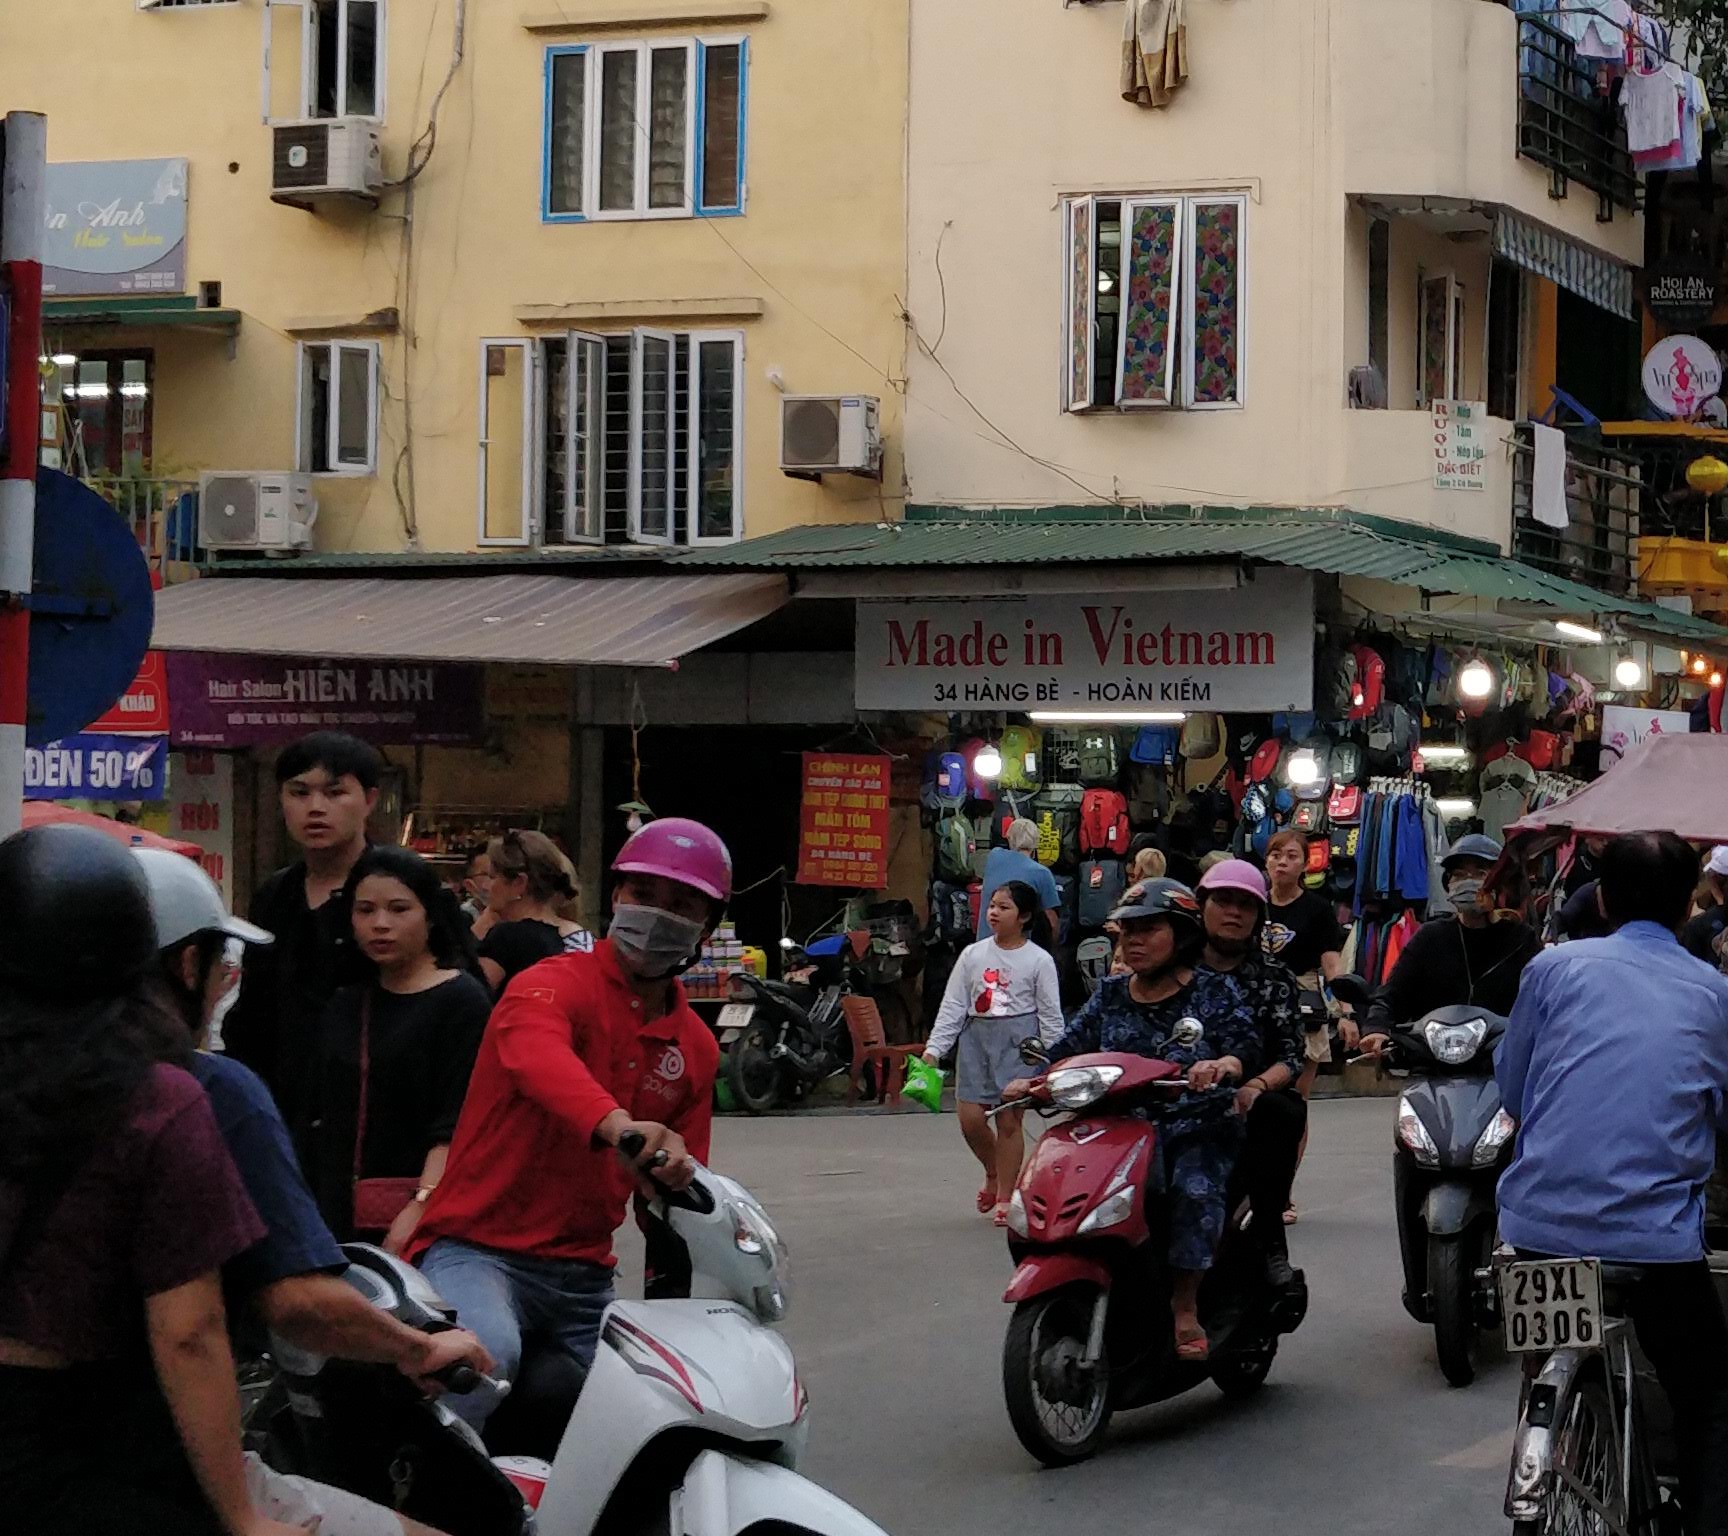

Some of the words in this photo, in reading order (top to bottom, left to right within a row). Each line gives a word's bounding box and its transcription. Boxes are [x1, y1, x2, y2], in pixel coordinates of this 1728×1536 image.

[1651, 287, 1714, 299] ROASTERY
[886, 619, 1008, 667] Made
[1023, 619, 1063, 666] in
[1080, 606, 1276, 667] Vietnam
[209, 680, 237, 698] Hair
[243, 680, 282, 698] Salon
[368, 667, 434, 702] ANH
[934, 682, 957, 702] 34
[965, 678, 1029, 702] HÀNG
[1037, 677, 1059, 702] BÈ
[1088, 678, 1152, 702] HOÀN
[1160, 675, 1211, 702] KIẾM
[90, 749, 153, 789] 50%
[1514, 1266, 1585, 1305] 29XL
[1512, 1307, 1592, 1347] 0306
